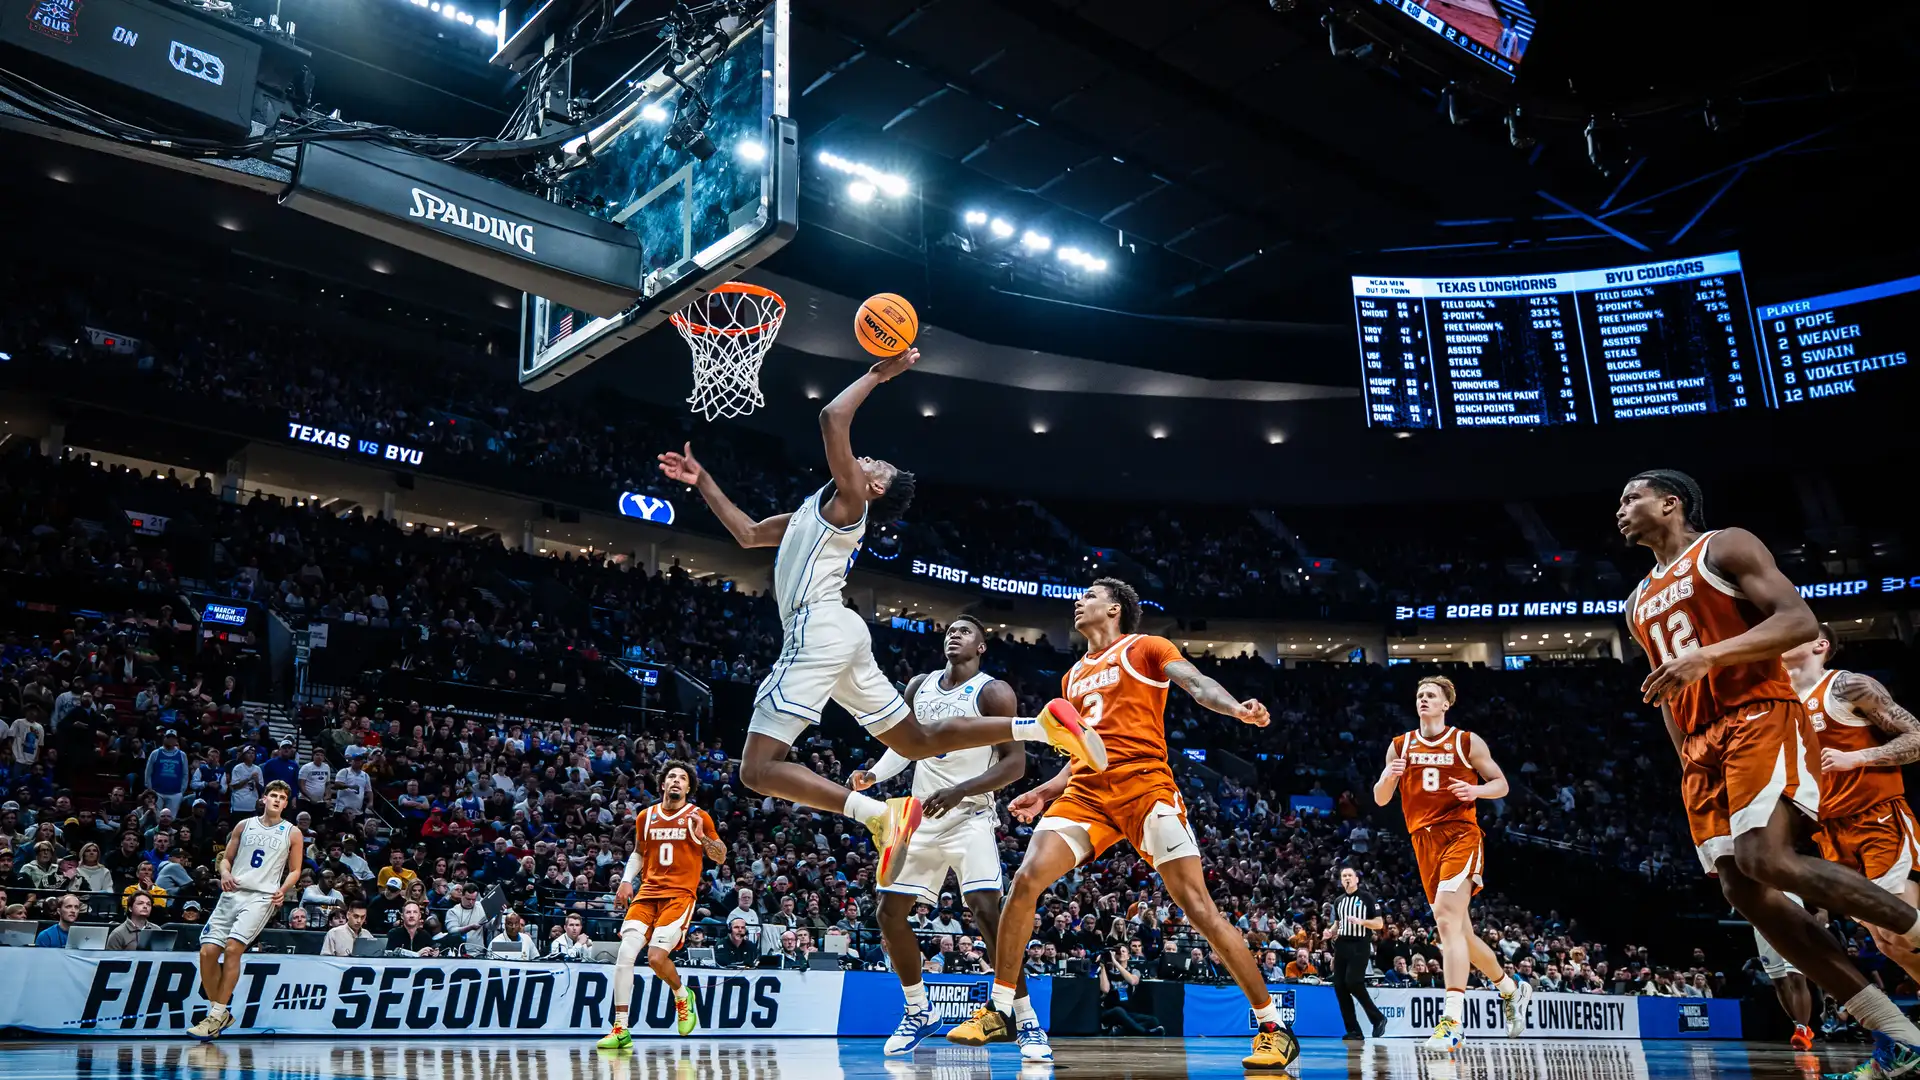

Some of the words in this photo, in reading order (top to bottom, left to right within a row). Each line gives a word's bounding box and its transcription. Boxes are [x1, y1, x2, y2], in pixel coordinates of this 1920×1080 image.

[1406, 3, 1421, 18] 4:08
[34, 12, 72, 32] FOUR
[112, 25, 139, 47] ON
[1446, 28, 1456, 40] 62
[174, 47, 220, 79] tbs
[410, 188, 534, 254] SPALDING
[1606, 270, 1634, 284] BYU
[1637, 261, 1704, 279] COUGARS
[1437, 281, 1476, 293] TEXAS
[1479, 278, 1557, 292] LONGHORNS
[1700, 279, 1713, 287] 44
[1595, 291, 1619, 300] FIELD
[1621, 288, 1644, 298] GOAL
[1644, 287, 1654, 296] %
[1361, 301, 1375, 309] TCU
[1441, 301, 1463, 309] FIELD
[1465, 300, 1486, 308] GOAL
[1486, 300, 1495, 308] %
[1597, 302, 1632, 312] 3-POINT
[1633, 300, 1643, 309] %
[1704, 302, 1717, 312] 75
[1767, 301, 1810, 317] PLAYER
[1443, 312, 1475, 320] 3-POINT
[1476, 312, 1485, 320] %
[1530, 309, 1550, 317] 33.3
[1598, 313, 1620, 324] FREE
[1621, 310, 1653, 321] THROW
[1654, 309, 1664, 318] %
[1717, 313, 1730, 322] 26
[1444, 323, 1463, 331] FREE
[1465, 323, 1494, 331] THROW
[1495, 322, 1504, 330] %
[1775, 321, 1786, 333] 0
[1796, 311, 1835, 329] POPE
[864, 314, 898, 348] Wilson
[1364, 327, 1382, 335] TROY
[1601, 323, 1648, 335] REBOUNDS
[1725, 325, 1732, 333] 4
[1446, 335, 1489, 343] REBOUNDS
[1552, 331, 1563, 340] 35
[1728, 336, 1735, 345] 6
[1778, 338, 1789, 350] 2
[1797, 324, 1861, 346] WEAVER
[1554, 342, 1565, 351] 13
[1603, 336, 1641, 347] ASSISTS
[1448, 346, 1482, 354] ASSISTS
[1604, 348, 1637, 358] STEALS
[1730, 349, 1737, 357] 2
[1781, 355, 1792, 367] 3
[1802, 344, 1855, 364] SWAIN
[1449, 358, 1479, 366] STEALS
[1560, 354, 1567, 362] 5
[1368, 361, 1381, 369] LOU
[1562, 366, 1569, 374] 4
[1606, 360, 1641, 370] BLOCKS
[1732, 361, 1740, 369] 6
[1784, 372, 1796, 384] 8
[1805, 351, 1907, 381] VOKIETAITIS
[1450, 370, 1482, 378] BLOCKS
[1608, 370, 1661, 382] TURNOVERS
[1728, 373, 1742, 382] 34
[1452, 381, 1500, 389] TURNOVERS
[1564, 378, 1571, 386] 9
[1610, 383, 1644, 394] POINTS
[1645, 382, 1657, 392] IN
[1658, 381, 1675, 390] THE
[1677, 377, 1705, 387] PAINT
[1371, 387, 1390, 395] WISC
[1560, 389, 1572, 398] 36
[1737, 386, 1744, 394] 0
[1784, 389, 1803, 402] 12
[1808, 379, 1856, 399] MARK
[1454, 392, 1484, 401] POINTS
[1486, 392, 1496, 400] IN
[1497, 392, 1512, 400] THE
[1513, 391, 1539, 400] PAINT
[1613, 396, 1642, 406] BENCH
[1644, 392, 1678, 403] POINTS
[1568, 401, 1575, 409] 7
[1734, 398, 1747, 406] 10
[1372, 404, 1395, 412] SIENA
[1455, 404, 1482, 413] BENCH
[1484, 404, 1515, 412] POINTS
[1614, 408, 1632, 418] 2ND
[1634, 405, 1669, 416] CHANCE
[1672, 402, 1706, 413] POINTS
[1374, 414, 1392, 422] DUKE
[1456, 417, 1473, 425] 2ND
[1475, 416, 1507, 424] CHANCE
[1509, 415, 1540, 424] POINTS
[1565, 413, 1576, 422] 14
[289, 423, 351, 449] TEXAS
[358, 440, 379, 454] VS
[385, 445, 423, 465] BYU
[630, 494, 664, 520] Y
[928, 563, 968, 584] FIRST
[982, 575, 1038, 595] SECOND
[1041, 584, 1085, 600] ROUN
[1795, 580, 1868, 599] NSHIP
[1638, 575, 1694, 625] TEXAS
[214, 606, 235, 615] MARCH
[1446, 604, 1492, 618] 2026
[1498, 603, 1519, 616] DI
[1524, 601, 1577, 615] MEN'S
[1582, 600, 1628, 614] BASK
[215, 613, 244, 623] MADNESS
[1649, 610, 1700, 664] 12
[1072, 665, 1120, 698] TEXAS
[1083, 692, 1103, 726] 3
[1409, 753, 1454, 765] TEXAS
[1422, 768, 1440, 791] 8
[650, 828, 687, 840] TEXAS
[245, 834, 281, 850] BYU
[250, 849, 265, 868] 6
[659, 843, 673, 866] 0
[272, 983, 328, 1010] AND
[332, 967, 556, 1029] SECOND
[930, 986, 969, 1001] MARCH
[1397, 1007, 1405, 1017] BY
[1411, 997, 1480, 1028] OREN
[1486, 999, 1533, 1029] STE
[1539, 1000, 1625, 1031] UNIVERSITY
